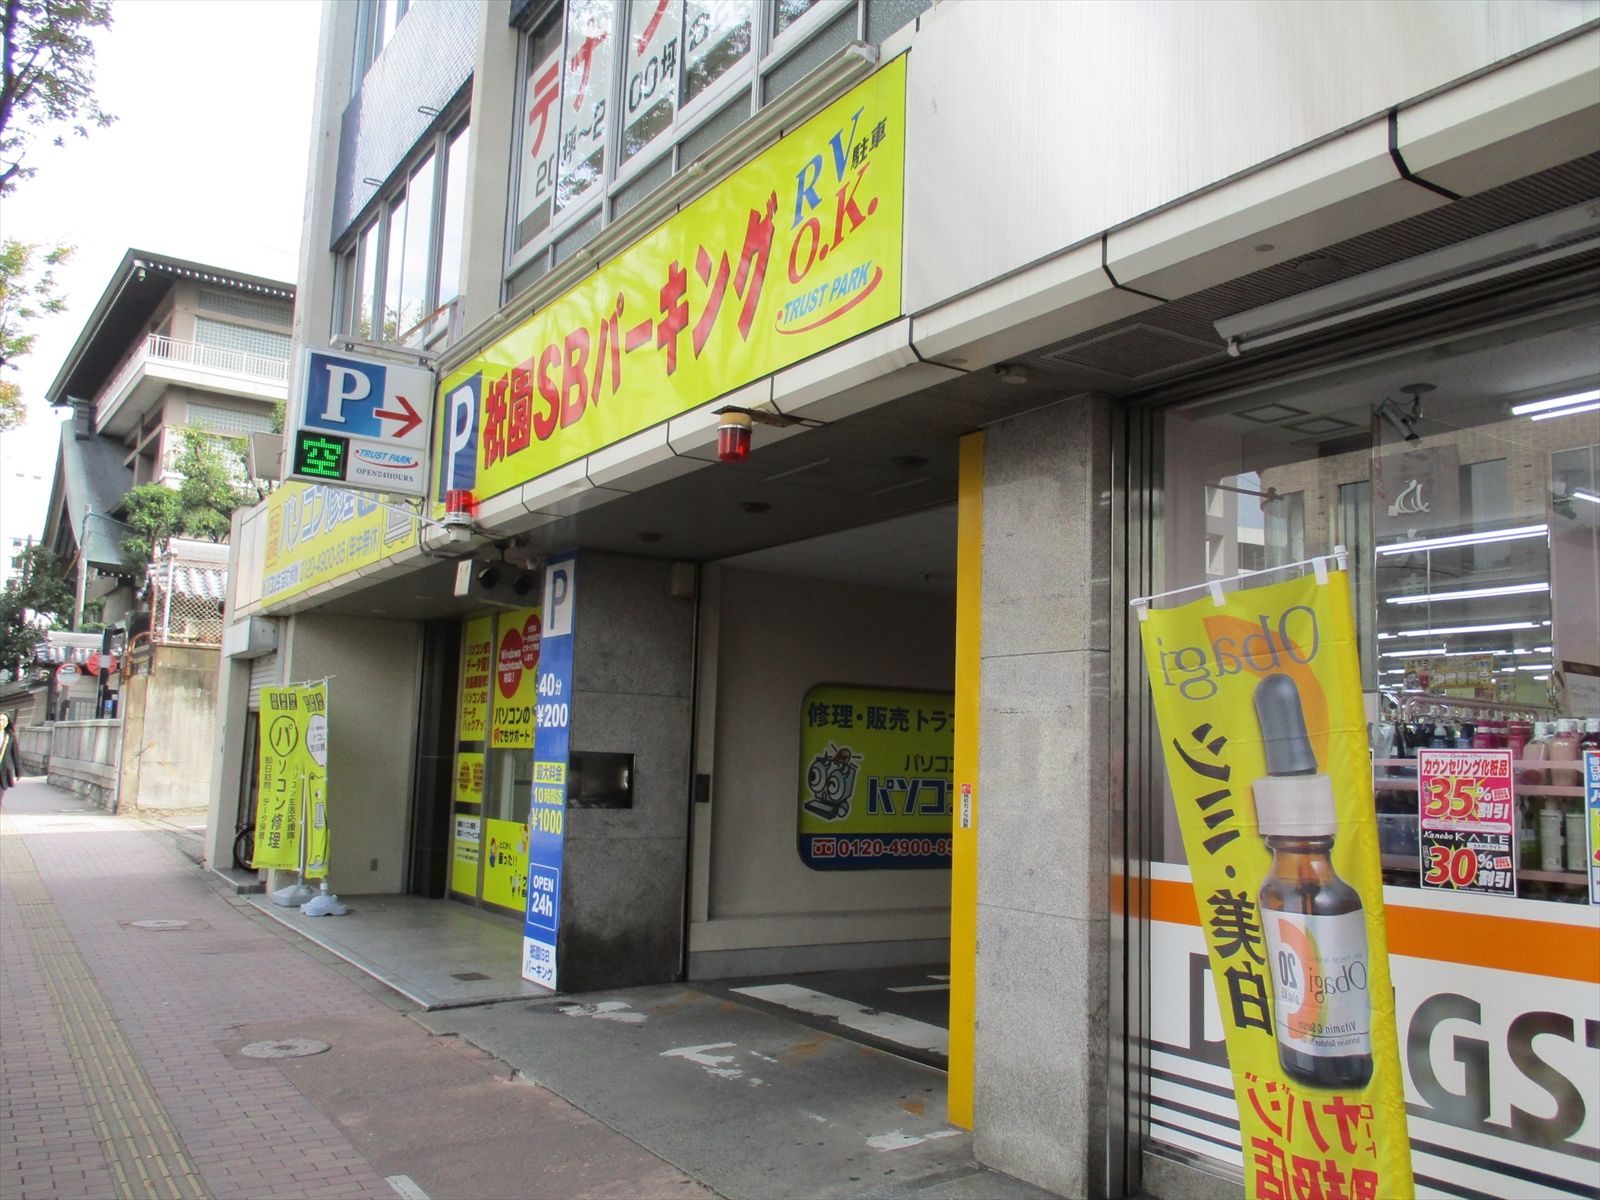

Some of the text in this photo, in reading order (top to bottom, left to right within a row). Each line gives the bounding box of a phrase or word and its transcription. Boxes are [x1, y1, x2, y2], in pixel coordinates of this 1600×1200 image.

[850, 117, 889, 171] 駐車
[788, 162, 879, 285] O.K.
[783, 261, 872, 326] TRUST PARK
[321, 364, 371, 423] P
[449, 386, 474, 489] P
[302, 438, 341, 477] 空
[359, 449, 413, 465] TRUST PARK
[550, 569, 568, 630] P
[539, 673, 562, 696] 40分
[494, 706, 530, 725] パソコンの
[536, 764, 562, 781] 最大料金
[904, 754, 954, 772] パソコ
[1423, 759, 1508, 776] カウンセリング化粧品
[867, 777, 953, 815] パソコ
[1478, 802, 1510, 819] 割引
[1424, 830, 1454, 840] Kanebo
[533, 875, 554, 893] OPEN
[1478, 869, 1511, 888] 割引
[531, 892, 553, 917] 24h
[525, 960, 553, 981] パーキング
